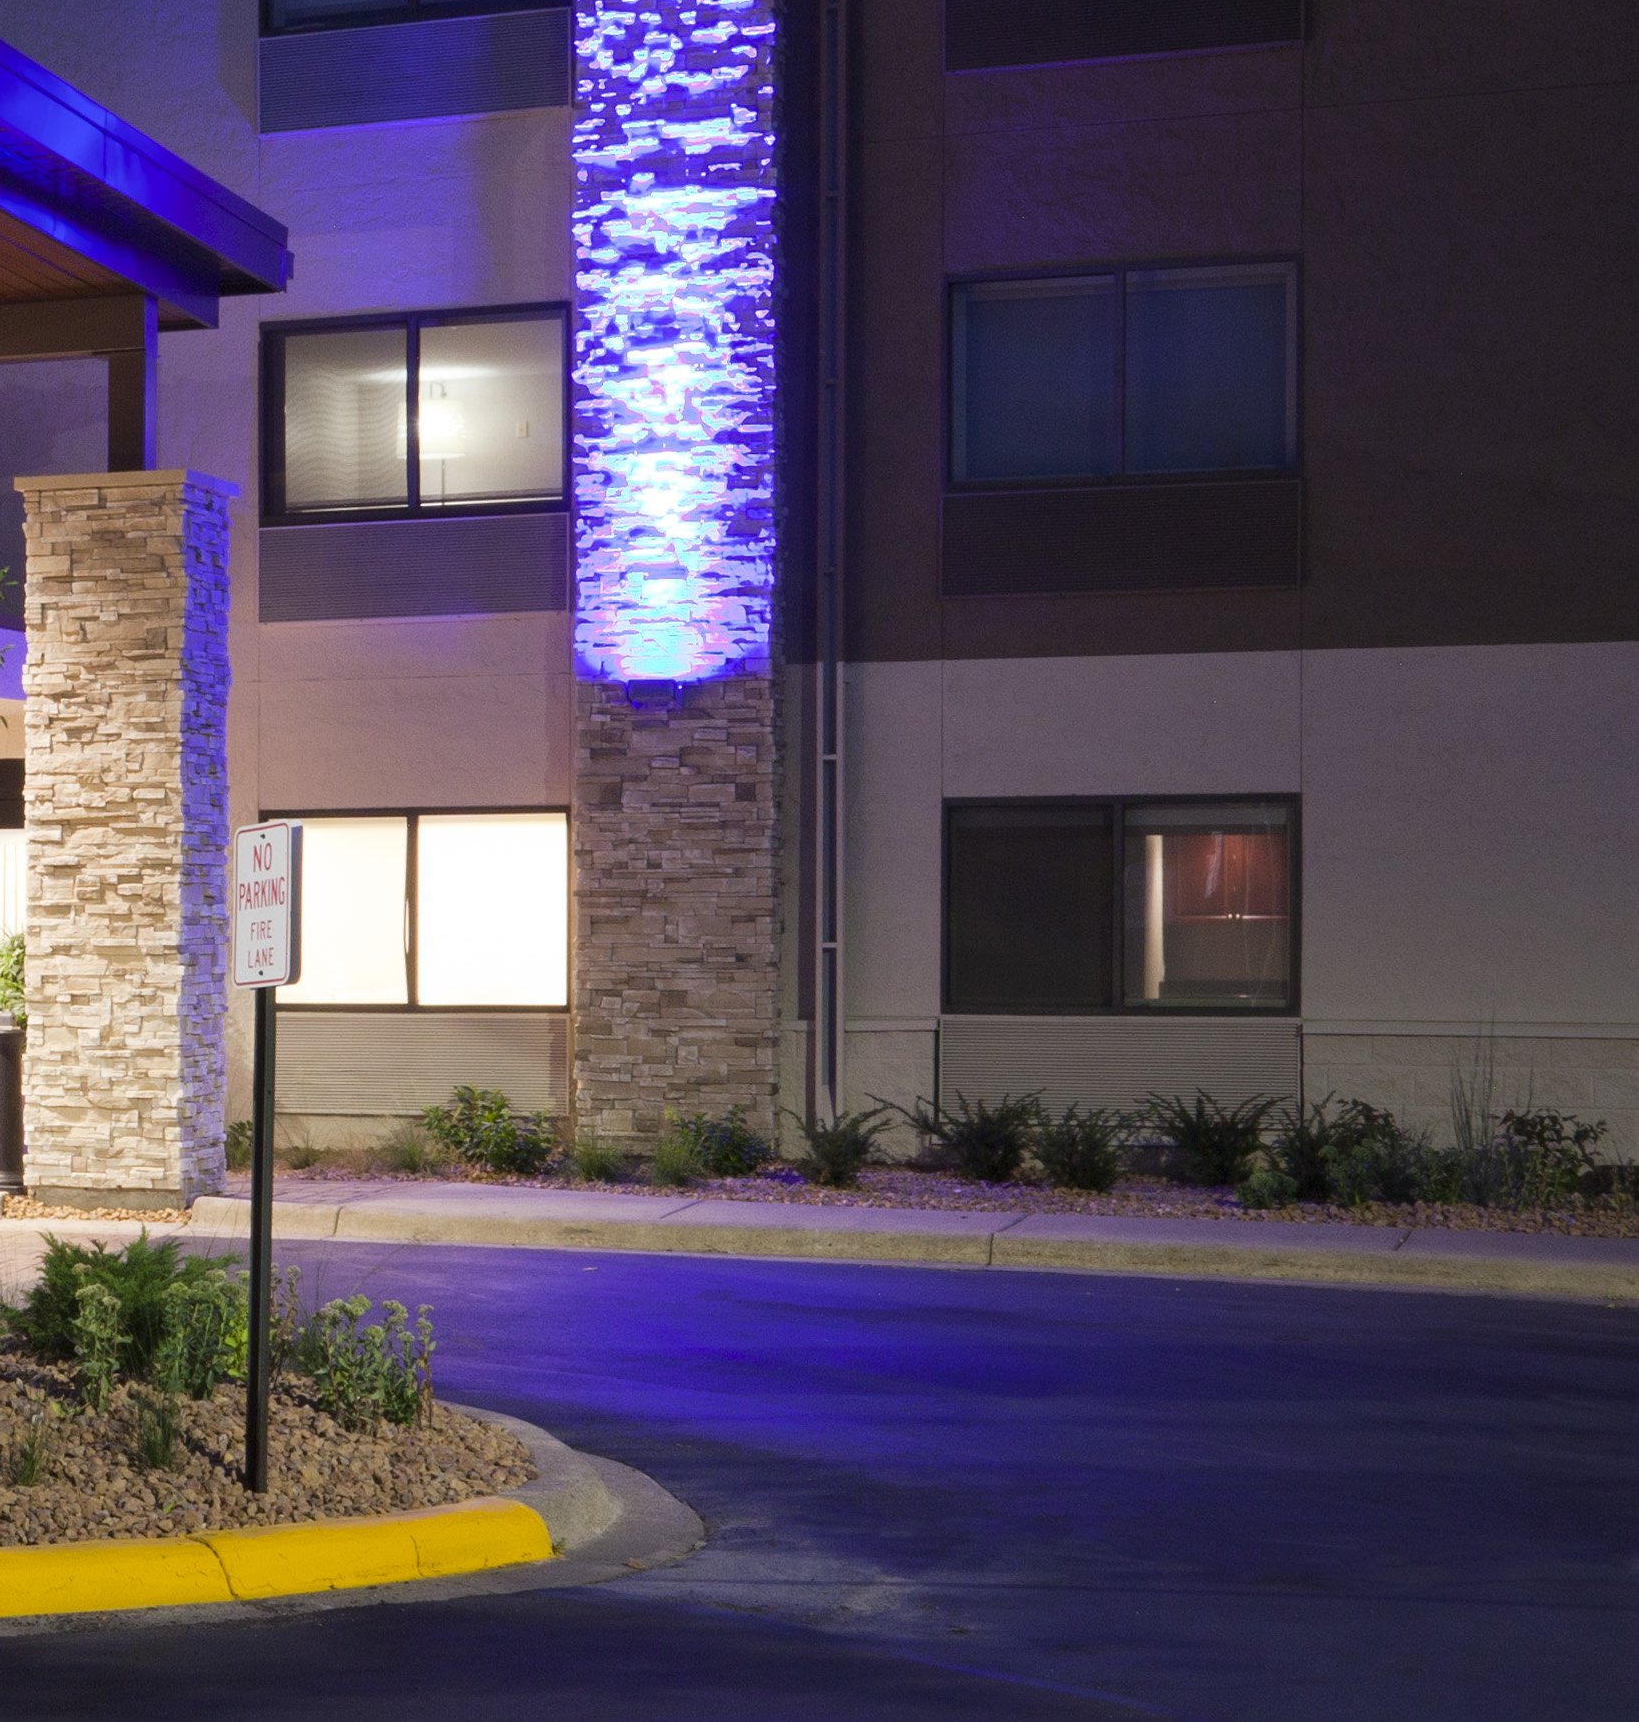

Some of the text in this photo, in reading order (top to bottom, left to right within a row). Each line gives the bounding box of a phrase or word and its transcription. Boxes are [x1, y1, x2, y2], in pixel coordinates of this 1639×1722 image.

[253, 842, 272, 872] NO
[239, 876, 285, 911] PARKING
[250, 920, 273, 941] FIRE
[248, 947, 274, 968] LANE
